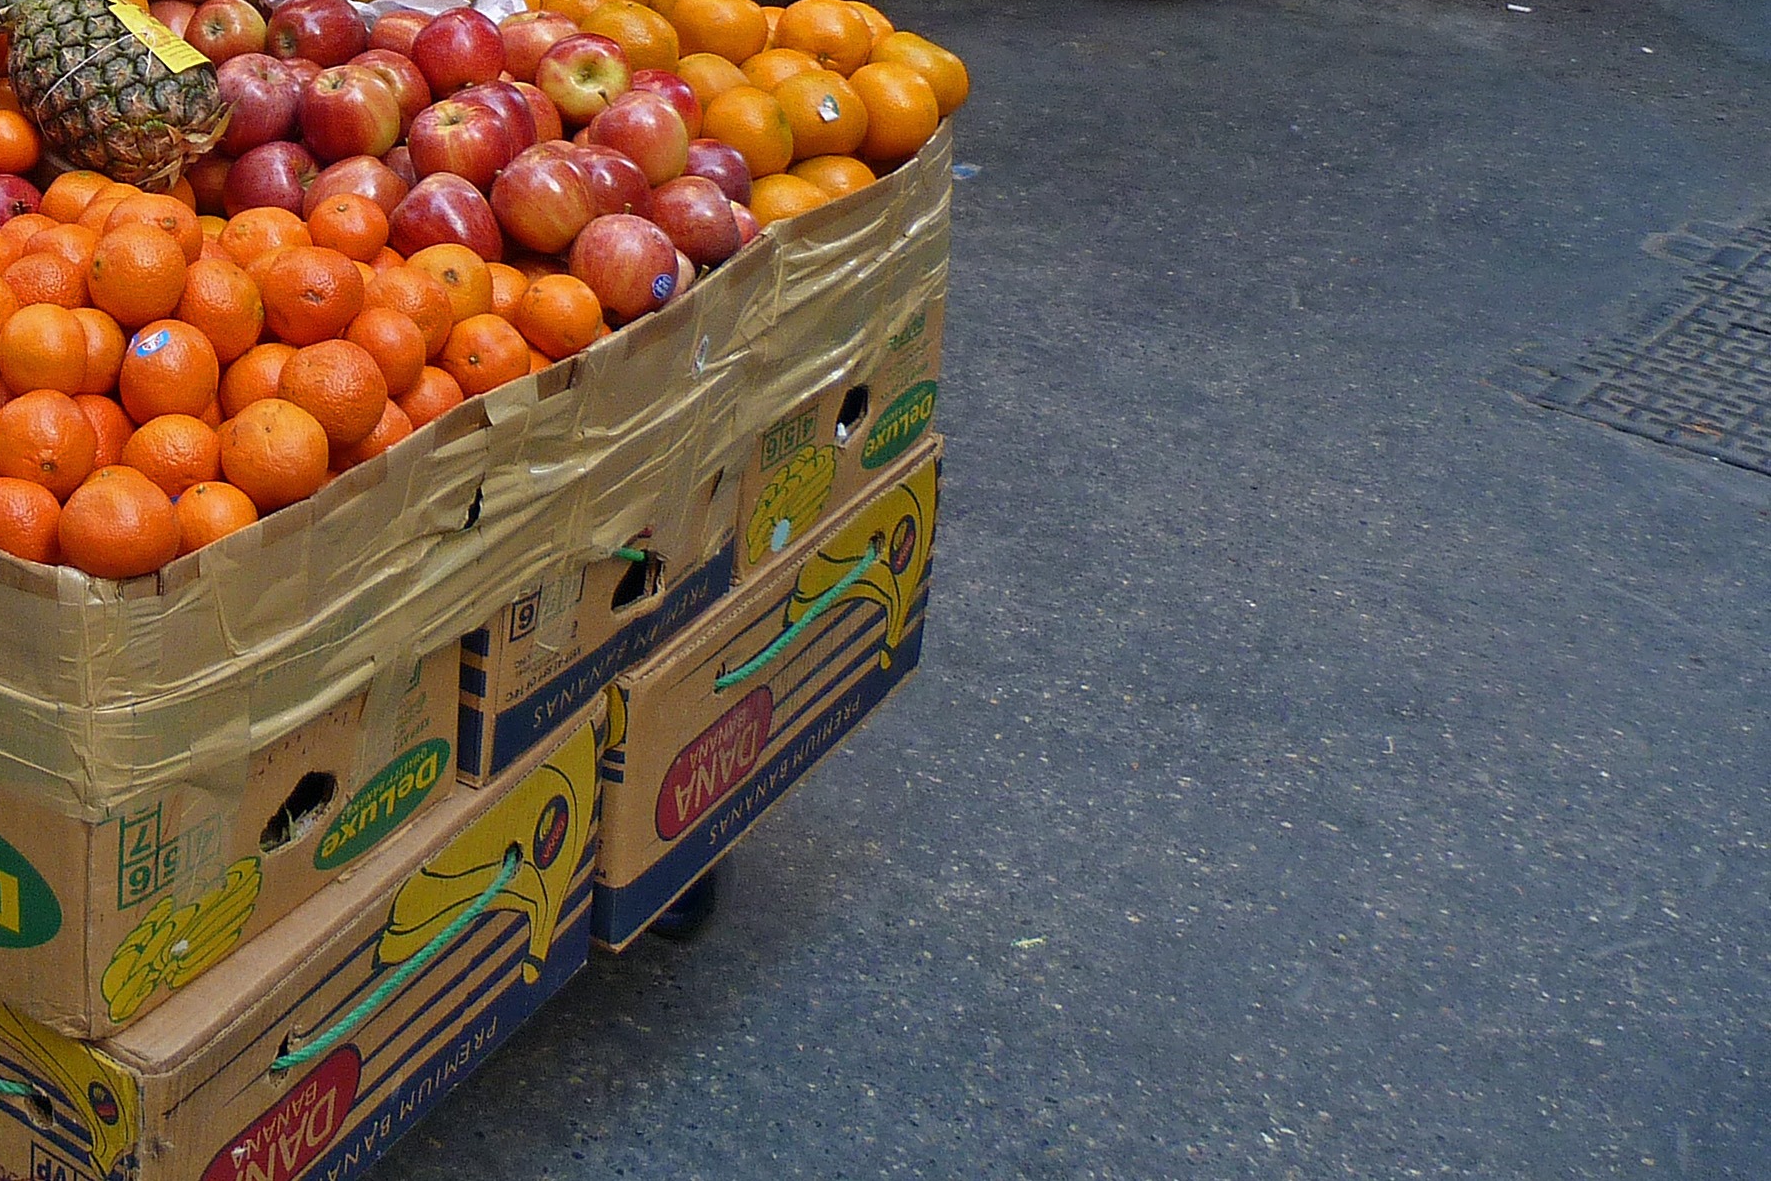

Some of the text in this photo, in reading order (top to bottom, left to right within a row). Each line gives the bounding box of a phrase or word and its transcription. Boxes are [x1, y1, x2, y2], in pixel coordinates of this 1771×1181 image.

[864, 391, 934, 459] DeLuxe
[517, 603, 535, 631] 6
[688, 707, 748, 765] BANANA
[708, 693, 862, 847] PREMIUM BANANAS
[672, 718, 759, 823] DANA
[129, 824, 152, 858] 7
[321, 751, 439, 863] DeLuxe
[129, 865, 152, 897] 6
[163, 845, 180, 880] 5
[234, 1085, 337, 1181] DAN
[310, 1017, 498, 1181] PREMIUM BANA
